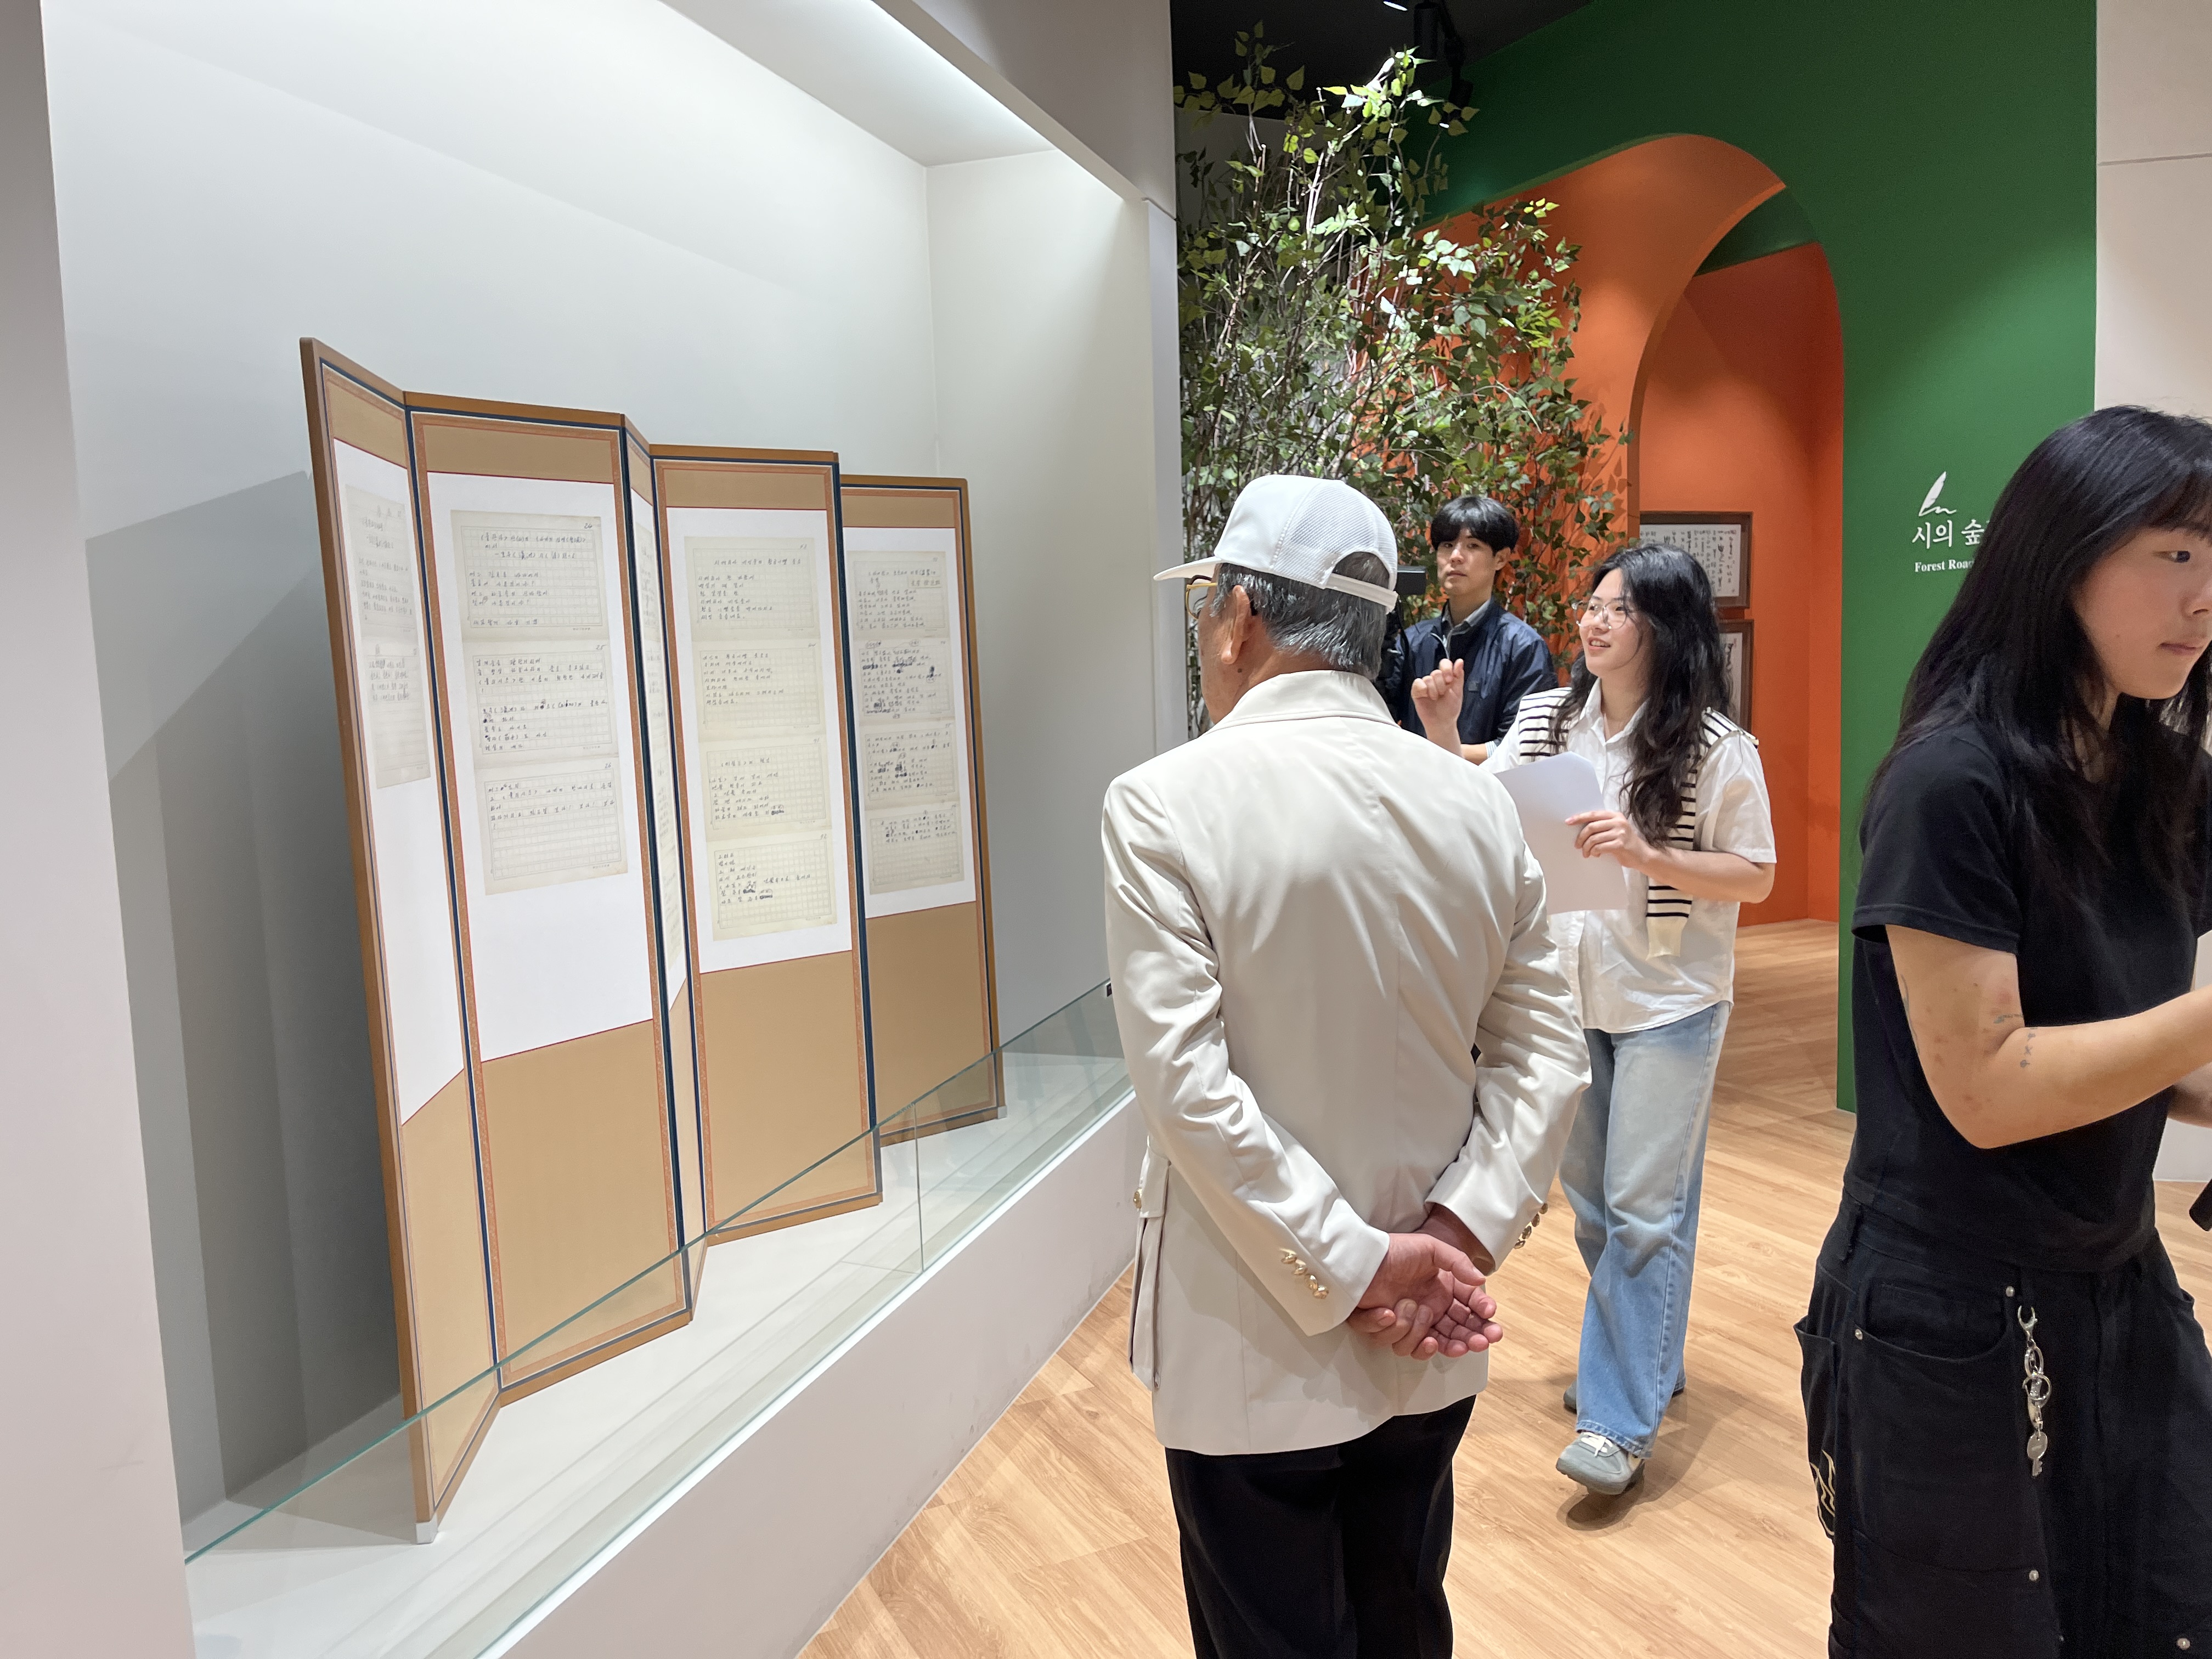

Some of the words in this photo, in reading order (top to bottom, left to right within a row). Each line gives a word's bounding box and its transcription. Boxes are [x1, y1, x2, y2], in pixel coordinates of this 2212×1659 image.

[1911, 519, 1953, 549] 시의
[1961, 518, 1990, 545] 숲
[1914, 561, 1945, 572] Forest
